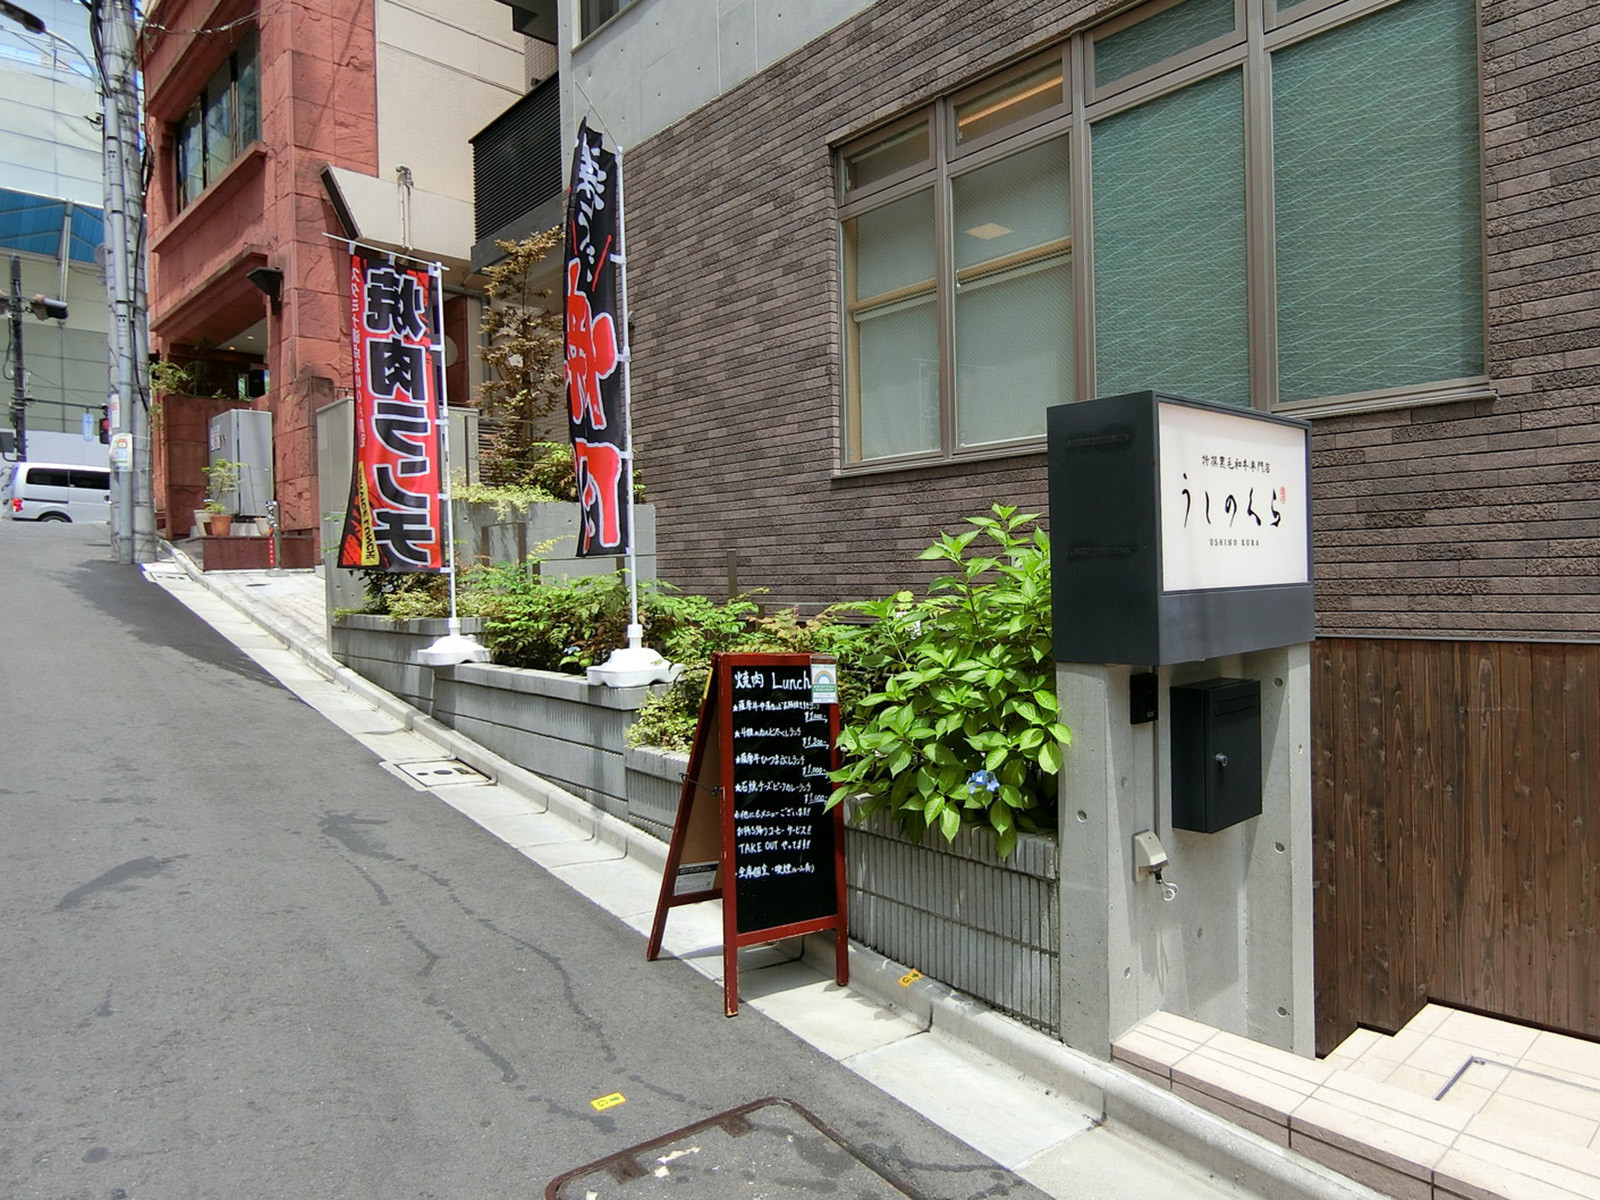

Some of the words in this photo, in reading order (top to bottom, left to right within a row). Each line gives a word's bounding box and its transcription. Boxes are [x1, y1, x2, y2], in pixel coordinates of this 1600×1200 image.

[1182, 473, 1281, 527] うしのくら
[735, 669, 764, 689] 焼肉
[771, 670, 811, 690] Lunch
[739, 842, 762, 854] TAKE
[764, 840, 778, 850] OUT
